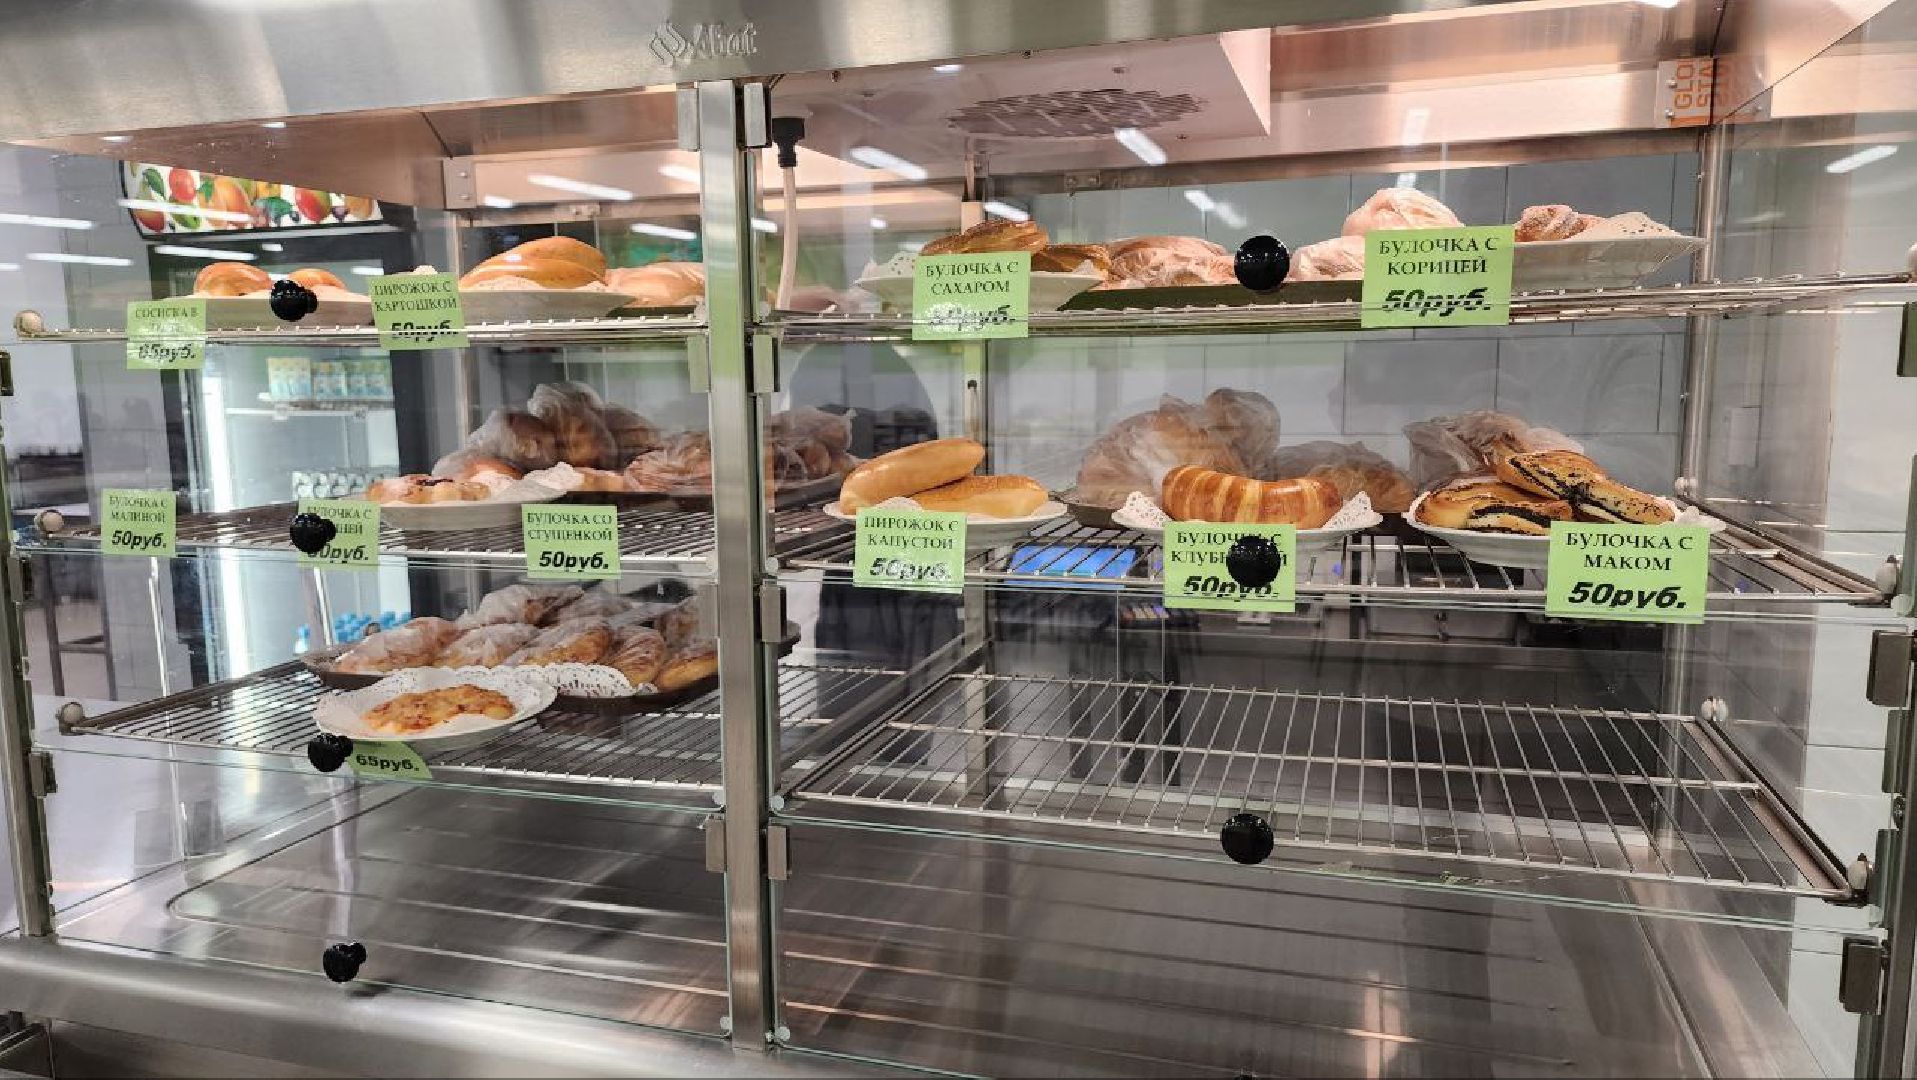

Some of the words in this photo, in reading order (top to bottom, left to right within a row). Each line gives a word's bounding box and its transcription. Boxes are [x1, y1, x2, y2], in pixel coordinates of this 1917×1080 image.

[1378, 238, 1479, 257] БУЛОЧКА
[1484, 237, 1500, 251] С
[926, 263, 1003, 280] БУЛОЧКА
[1006, 261, 1019, 273] С
[1387, 255, 1488, 276] КОРИЦЕЙ
[374, 282, 441, 296] ПИРОЖОК
[442, 280, 453, 293] С
[931, 280, 1010, 296] САХАРОМ
[374, 295, 457, 312] КАРТОШКОЙ
[1381, 286, 1492, 318] 50руб.
[391, 320, 459, 342] 50руб.
[109, 495, 158, 509] БУЛОЧКА
[160, 498, 168, 509] С
[111, 510, 165, 523] МАЛИНОЙ
[363, 508, 373, 520] С
[527, 512, 591, 526] БУЛОЧКА
[592, 514, 612, 525] СО
[864, 516, 944, 532] ПИРОЖОК
[948, 520, 959, 532] С
[111, 530, 167, 550] 50руб.
[528, 527, 612, 542] СГУЩЕНКОЙ
[867, 534, 953, 550] КАПУСТОЙ
[1565, 532, 1673, 550] БУЛОЧКА
[1678, 536, 1694, 550] С
[307, 545, 369, 564] 0руб.
[539, 551, 609, 573] 50руб.
[1583, 554, 1672, 571] МАКОМ
[869, 557, 952, 581] 50руб.
[1568, 581, 1687, 612] 50руб.
[356, 753, 420, 772] 65руб.
